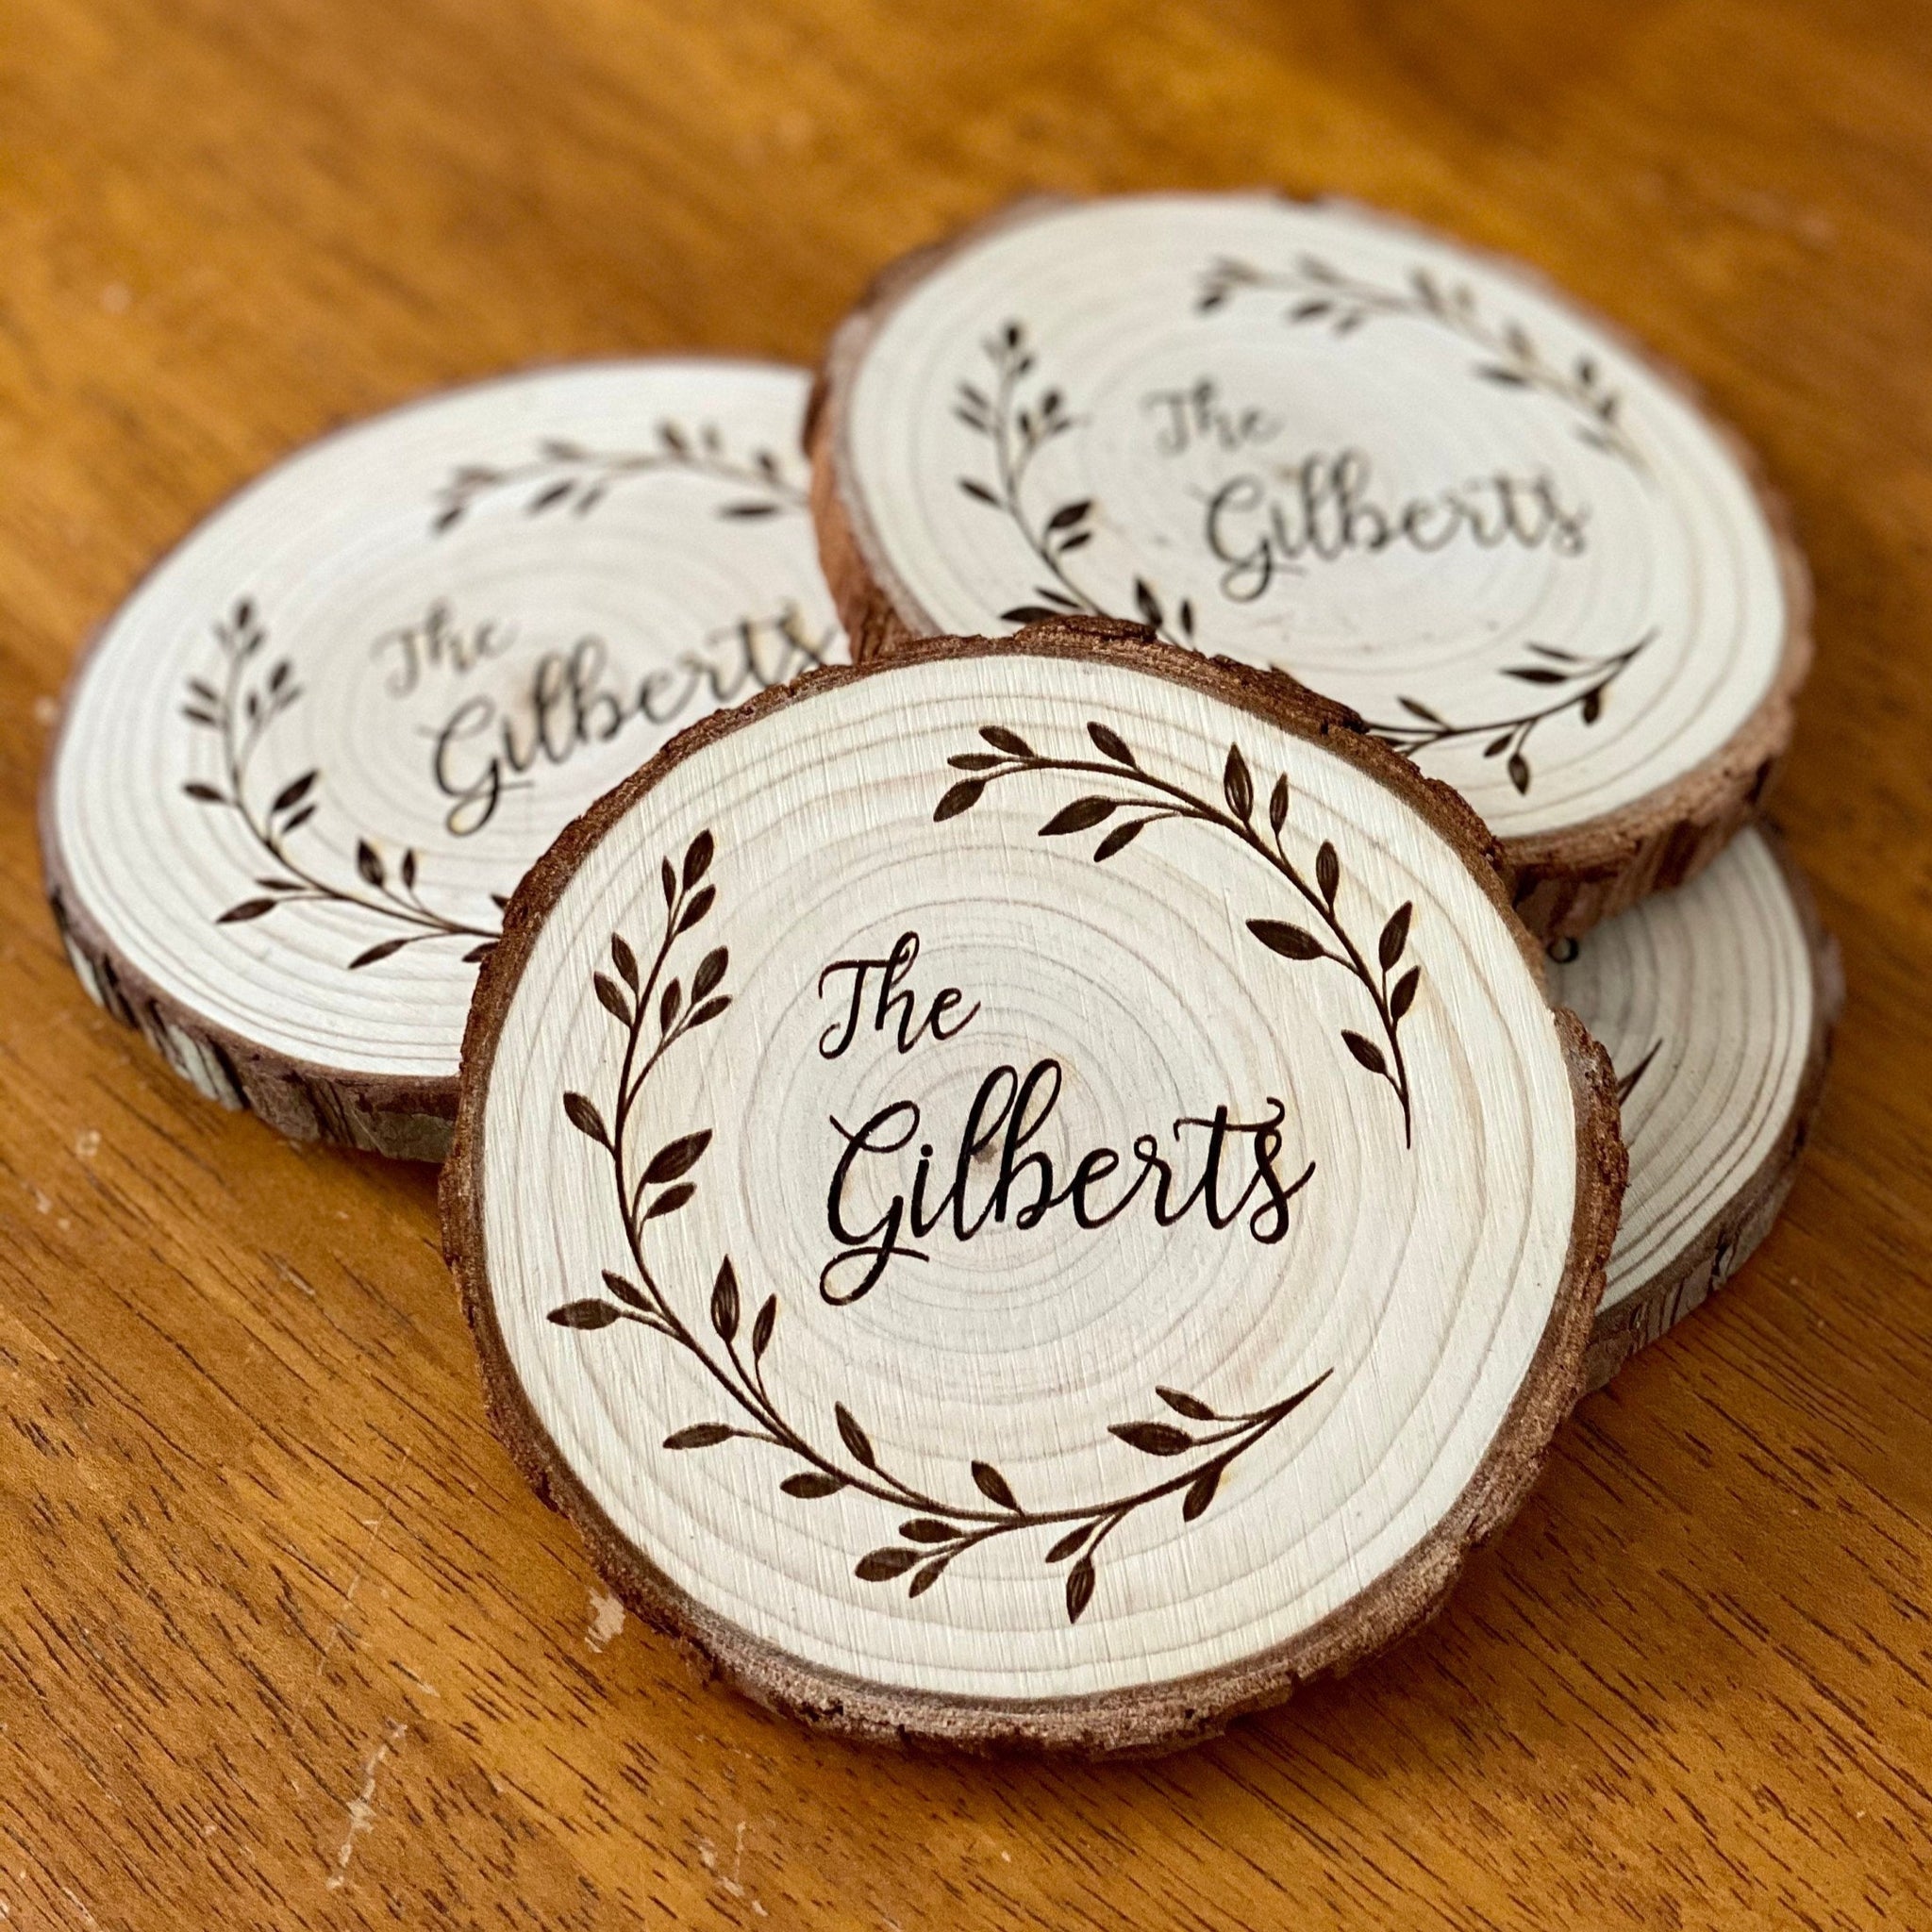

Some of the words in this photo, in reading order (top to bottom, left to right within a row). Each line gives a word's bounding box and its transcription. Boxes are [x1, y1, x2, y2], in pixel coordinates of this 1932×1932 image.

[1141, 374, 1285, 454] The
[1185, 449, 1591, 603] Gilberts
[368, 595, 520, 700] The
[818, 930, 981, 1059] The
[819, 1058, 1316, 1307] Gilberts
